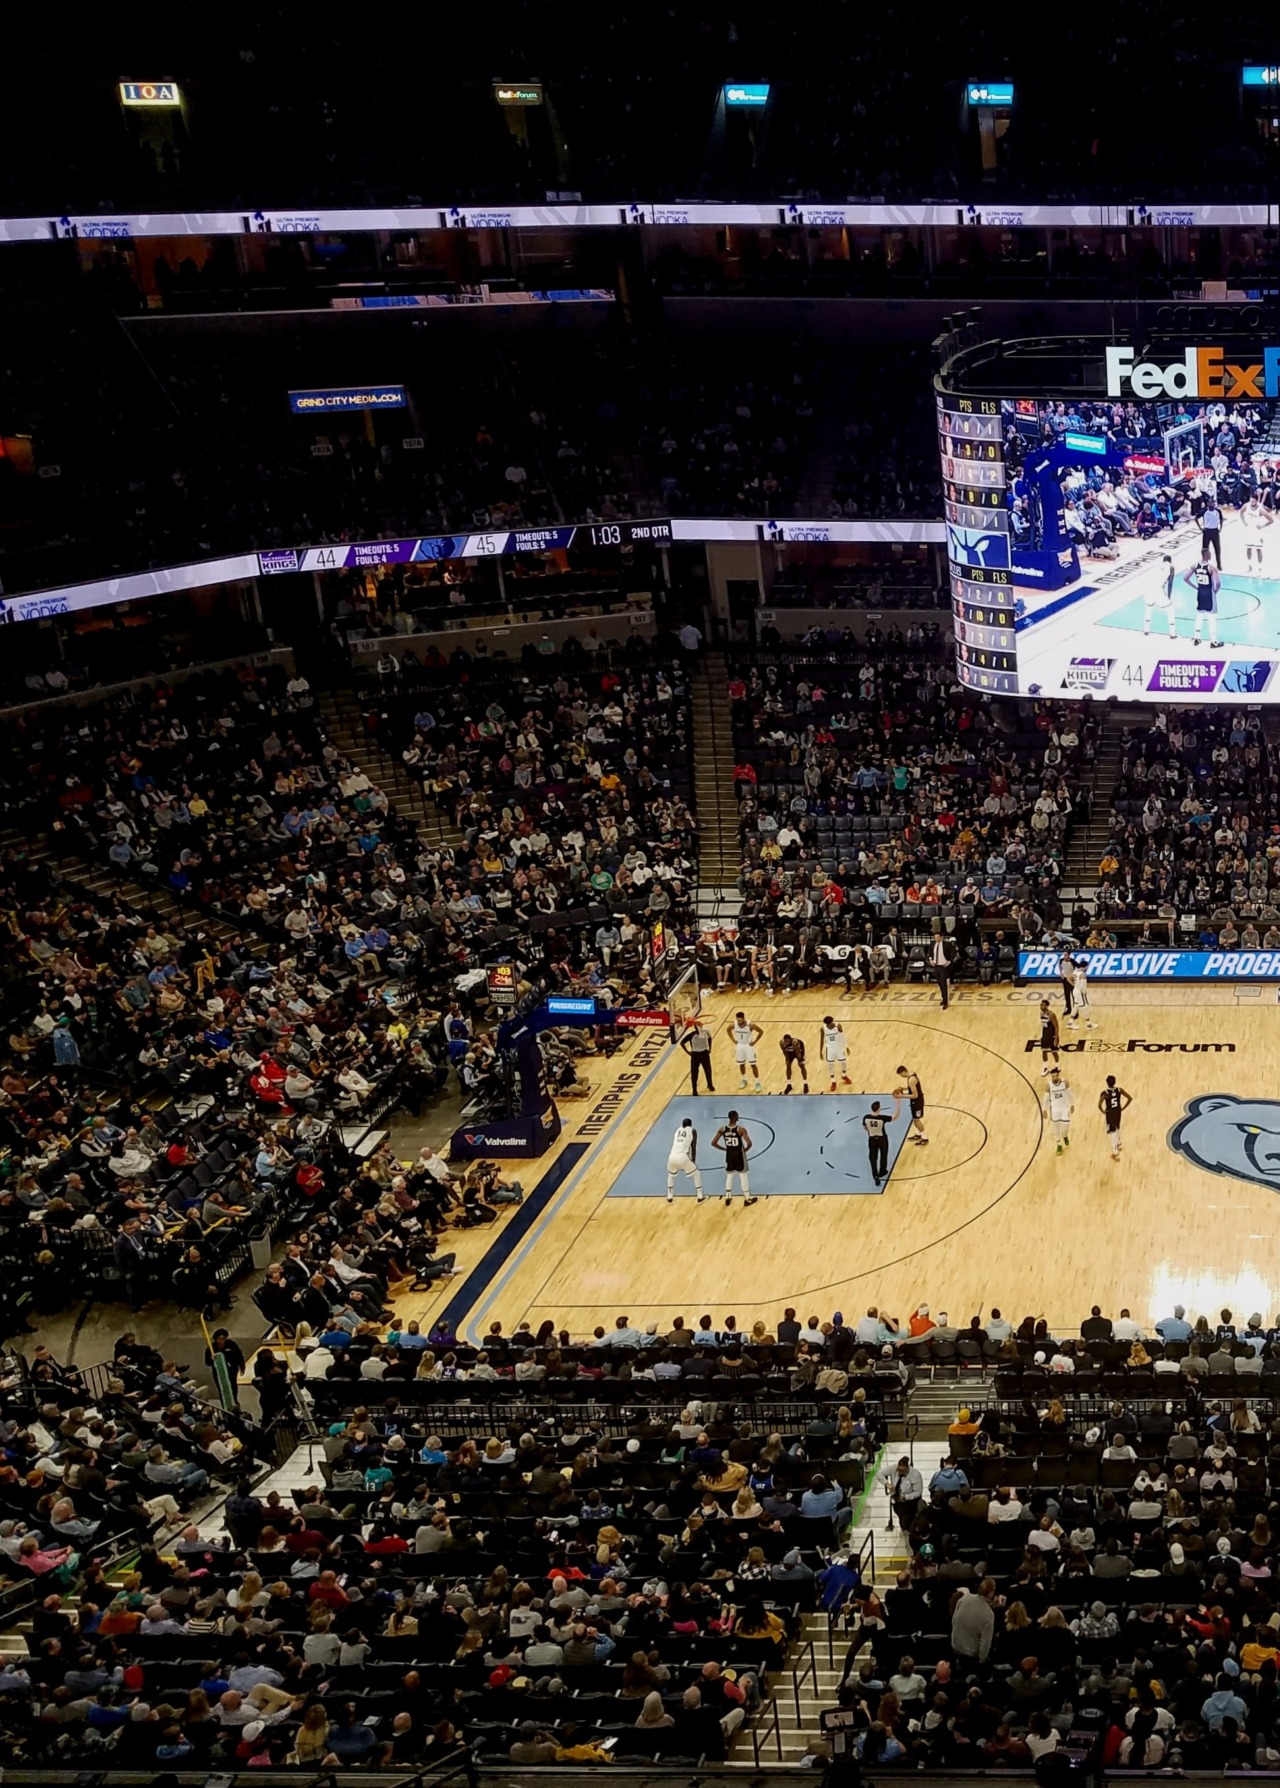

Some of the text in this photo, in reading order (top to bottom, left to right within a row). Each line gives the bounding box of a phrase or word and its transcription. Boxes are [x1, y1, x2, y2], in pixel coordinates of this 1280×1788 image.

[82, 228, 130, 237] VODKA
[277, 223, 321, 232] VODKA
[297, 394, 401, 408] GRIND CITY MEDIA.COM
[960, 400, 996, 414] PTS FLS
[515, 531, 558, 542] TIMEOUTS: 5
[591, 526, 621, 545] 1:03
[632, 525, 669, 539] 2ND QTR
[354, 543, 399, 555] TIMEOUTS: 5
[477, 535, 495, 554] 45
[516, 542, 540, 551] FOULS:
[317, 549, 336, 567] 44
[356, 555, 387, 565] FOULS: 4
[262, 560, 297, 569] KINGS
[972, 569, 984, 581] PTS
[993, 572, 1007, 584] FLS
[1067, 671, 1106, 680] KINGS
[1122, 665, 1143, 686] 44
[1159, 665, 1216, 677] TIMEOUTS: 5
[1159, 677, 1199, 688] FOULS: 4
[549, 1002, 592, 1010] PROGRESSIVE
[1024, 1039, 1236, 1053] FdExForum
[576, 1073, 641, 1135] MEMPHIS
[1111, 1097, 1118, 1108] 5
[485, 1137, 527, 1146] Valvoline
[726, 1137, 738, 1146] 20
